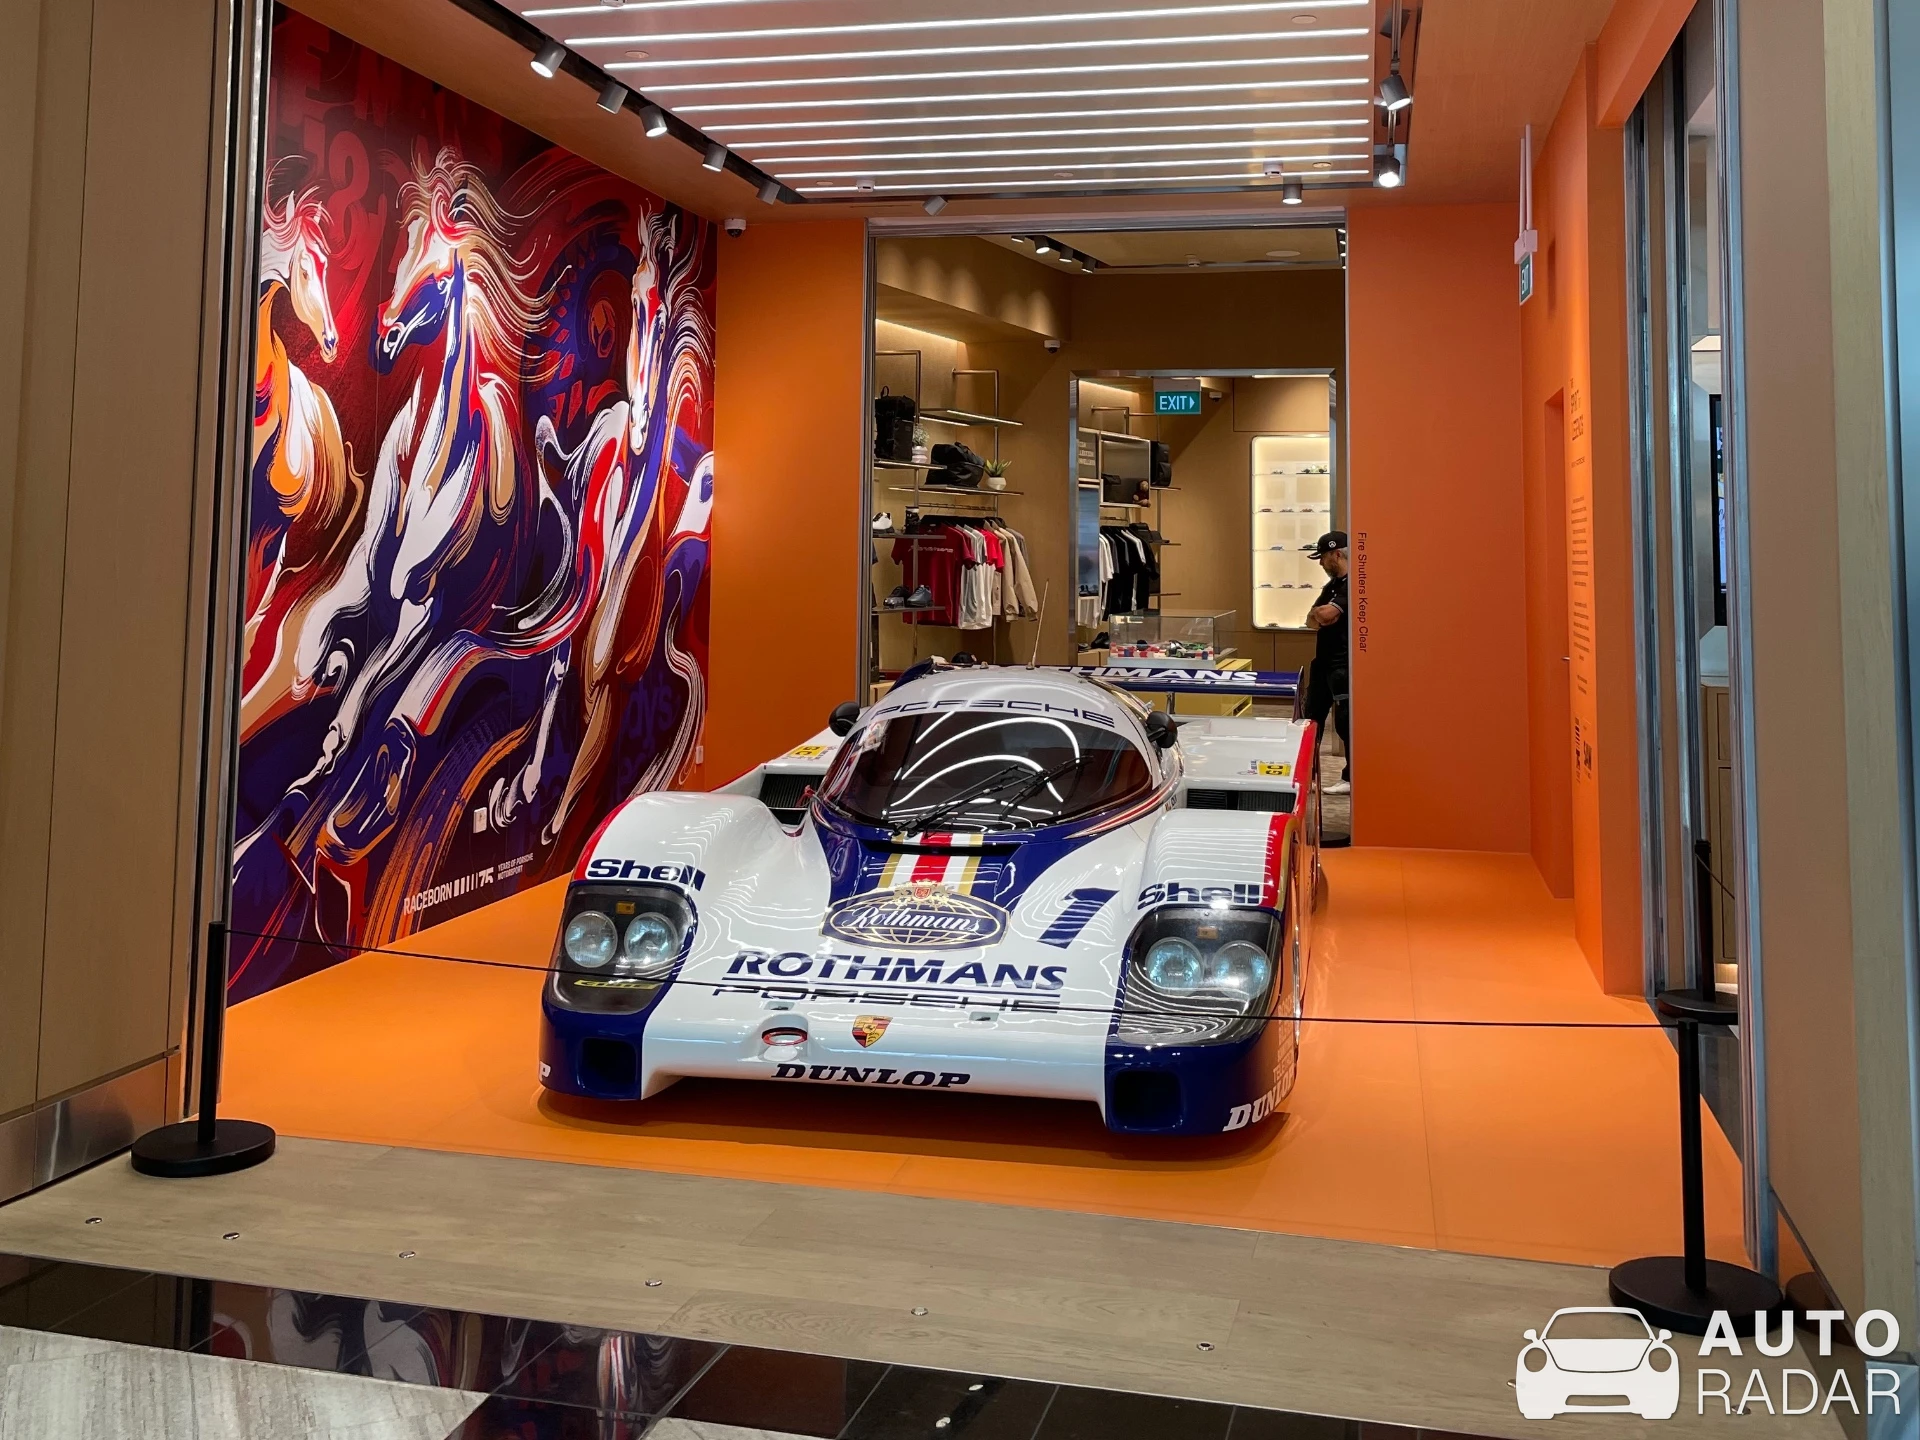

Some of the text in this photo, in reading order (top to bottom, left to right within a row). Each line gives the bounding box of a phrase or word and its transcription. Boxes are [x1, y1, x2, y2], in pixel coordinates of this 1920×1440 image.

[1160, 395, 1188, 410] EXIT
[1357, 532, 1369, 652] Fire Shutters Keep Clear
[1056, 666, 1258, 681] HMANS
[498, 852, 534, 873] YEARS OF PORSCHE
[498, 864, 523, 880] MOTORSPORT
[587, 858, 706, 892] Shell
[403, 866, 495, 915] RACEBORN 75
[1137, 882, 1260, 911] Shell
[840, 905, 983, 936] Rothmans
[1036, 888, 1119, 949] 1
[726, 950, 1068, 990] ROTHMANS
[712, 984, 1060, 1014] PORSCHE
[771, 1063, 971, 1088] DUNLOP
